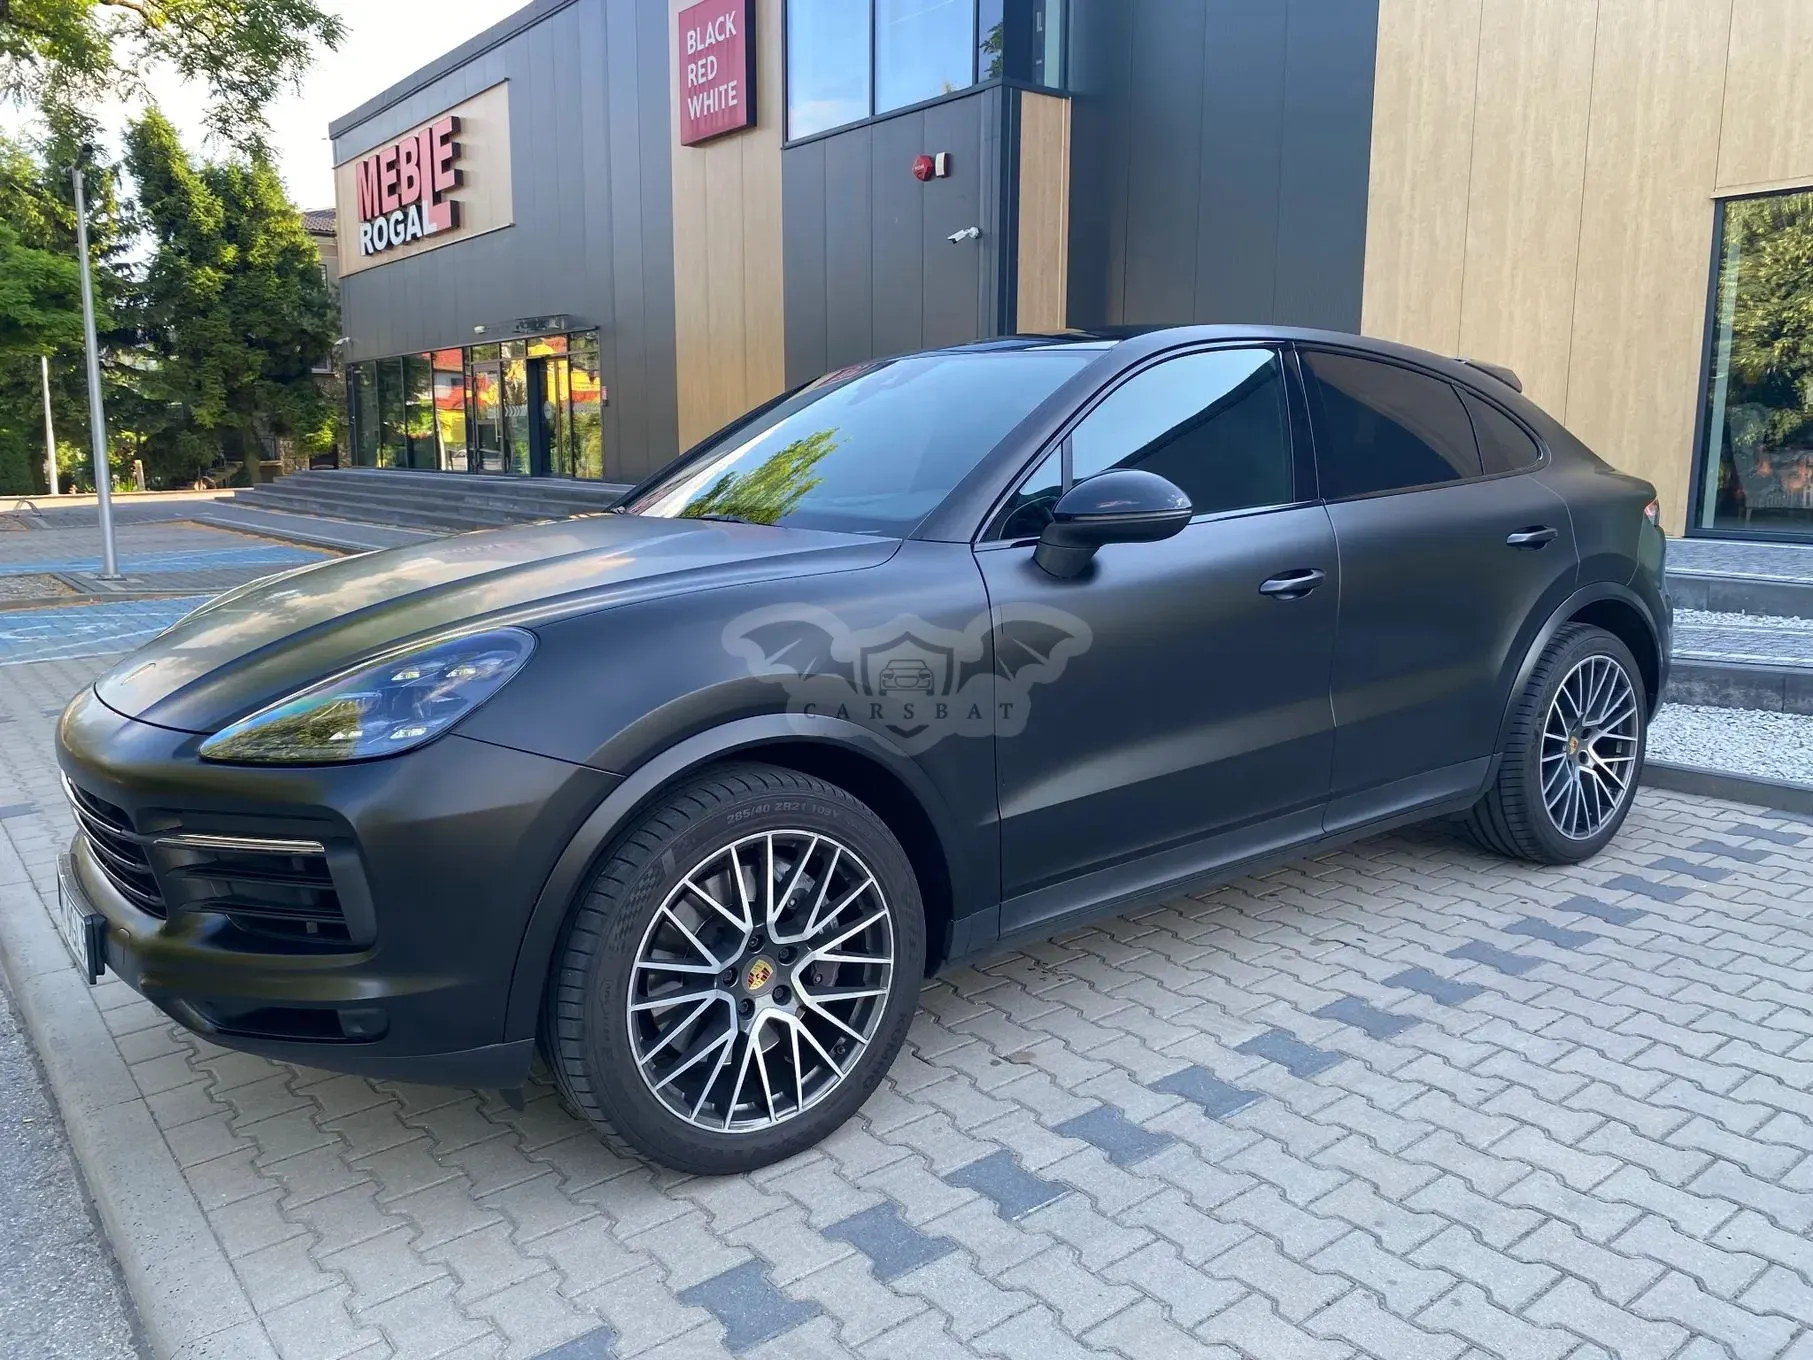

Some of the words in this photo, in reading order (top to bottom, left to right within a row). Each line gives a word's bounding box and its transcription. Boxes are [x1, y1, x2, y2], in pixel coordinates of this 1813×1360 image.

[687, 10, 737, 55] BLACK
[687, 55, 718, 88] RED
[687, 80, 738, 120] WHITE
[356, 115, 460, 231] MEBLE
[358, 199, 437, 256] ROGAL
[727, 803, 770, 825] 285/40
